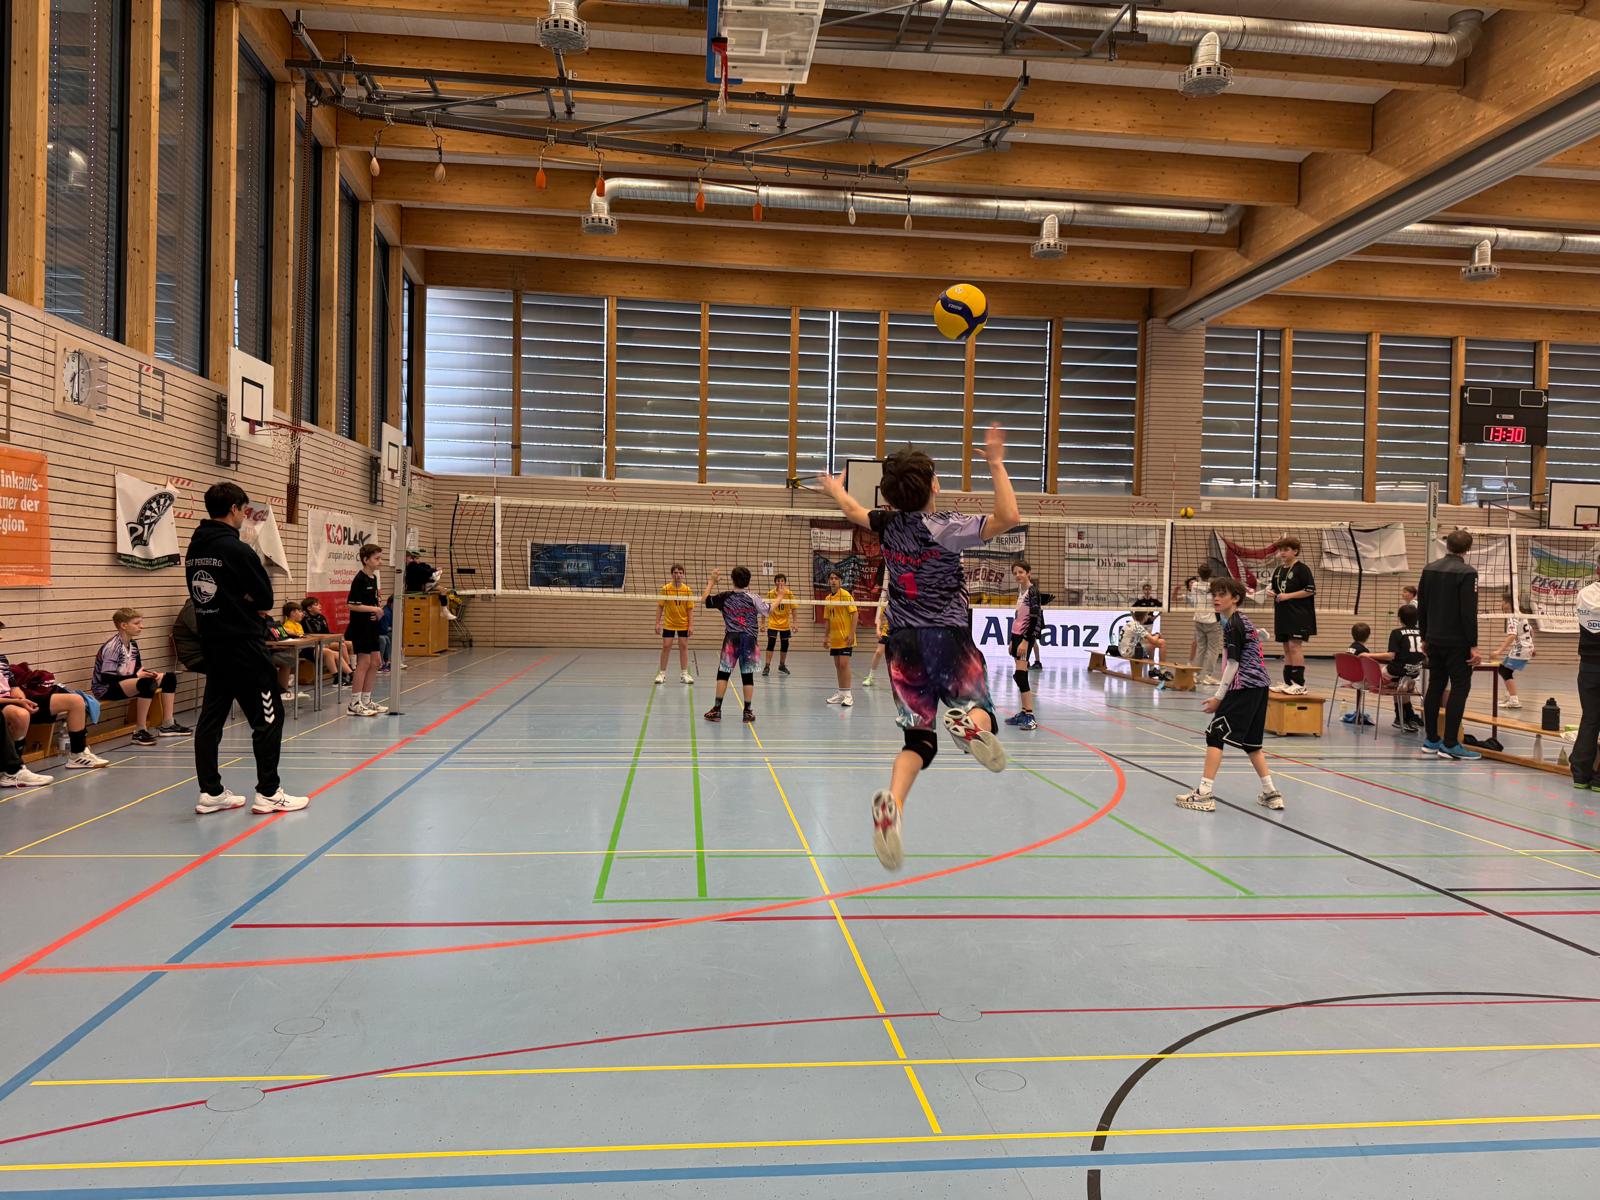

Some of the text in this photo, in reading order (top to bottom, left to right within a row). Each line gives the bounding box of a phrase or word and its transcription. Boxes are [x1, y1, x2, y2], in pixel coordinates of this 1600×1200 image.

[1489, 427, 1524, 443] 13:30
[20, 494, 40, 512] der
[1097, 558, 1126, 568] DiVino
[979, 616, 1100, 648] Alanz
